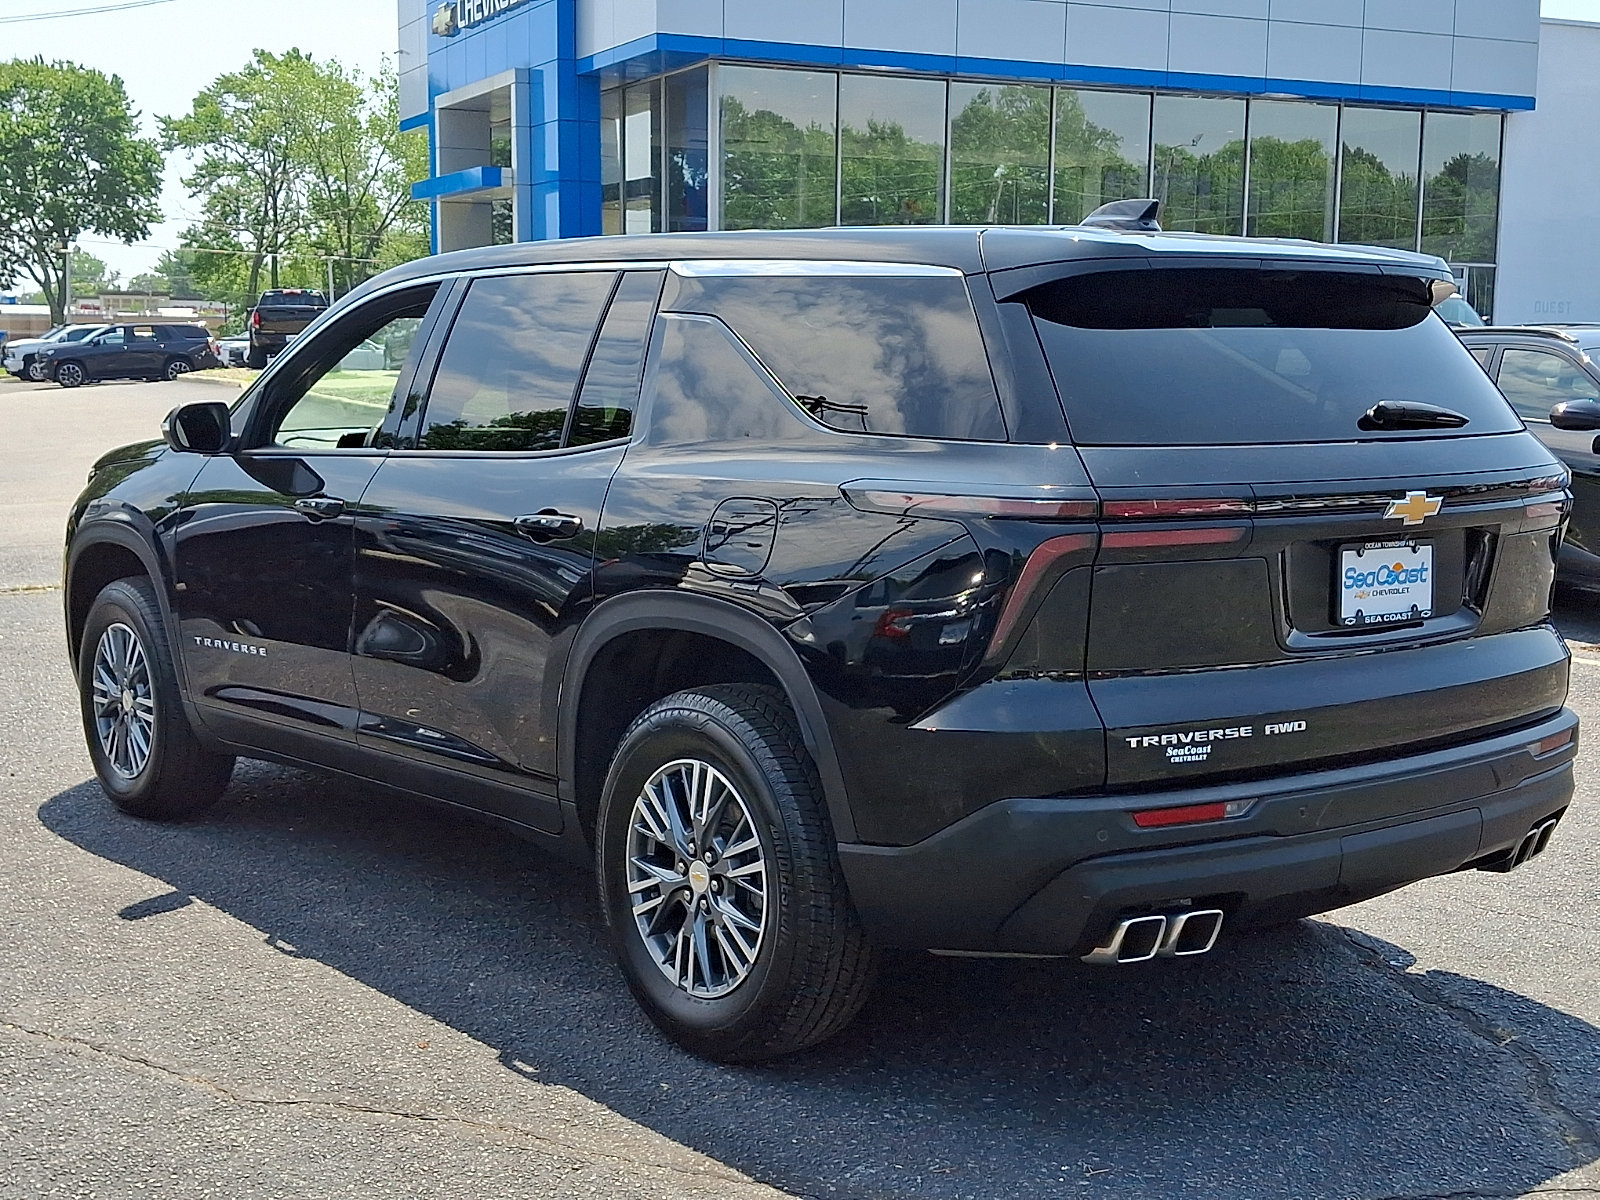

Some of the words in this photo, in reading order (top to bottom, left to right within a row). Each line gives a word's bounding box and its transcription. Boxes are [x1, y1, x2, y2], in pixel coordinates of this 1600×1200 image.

[1372, 587, 1410, 597] CHEVROLET
[1364, 614, 1383, 624] SEA
[1383, 612, 1413, 622] COAST
[194, 636, 268, 657] TRAVERSE
[1125, 726, 1253, 749] TRAVERSE
[1264, 720, 1307, 735] AWD
[1170, 754, 1208, 763] CHEVROLET
